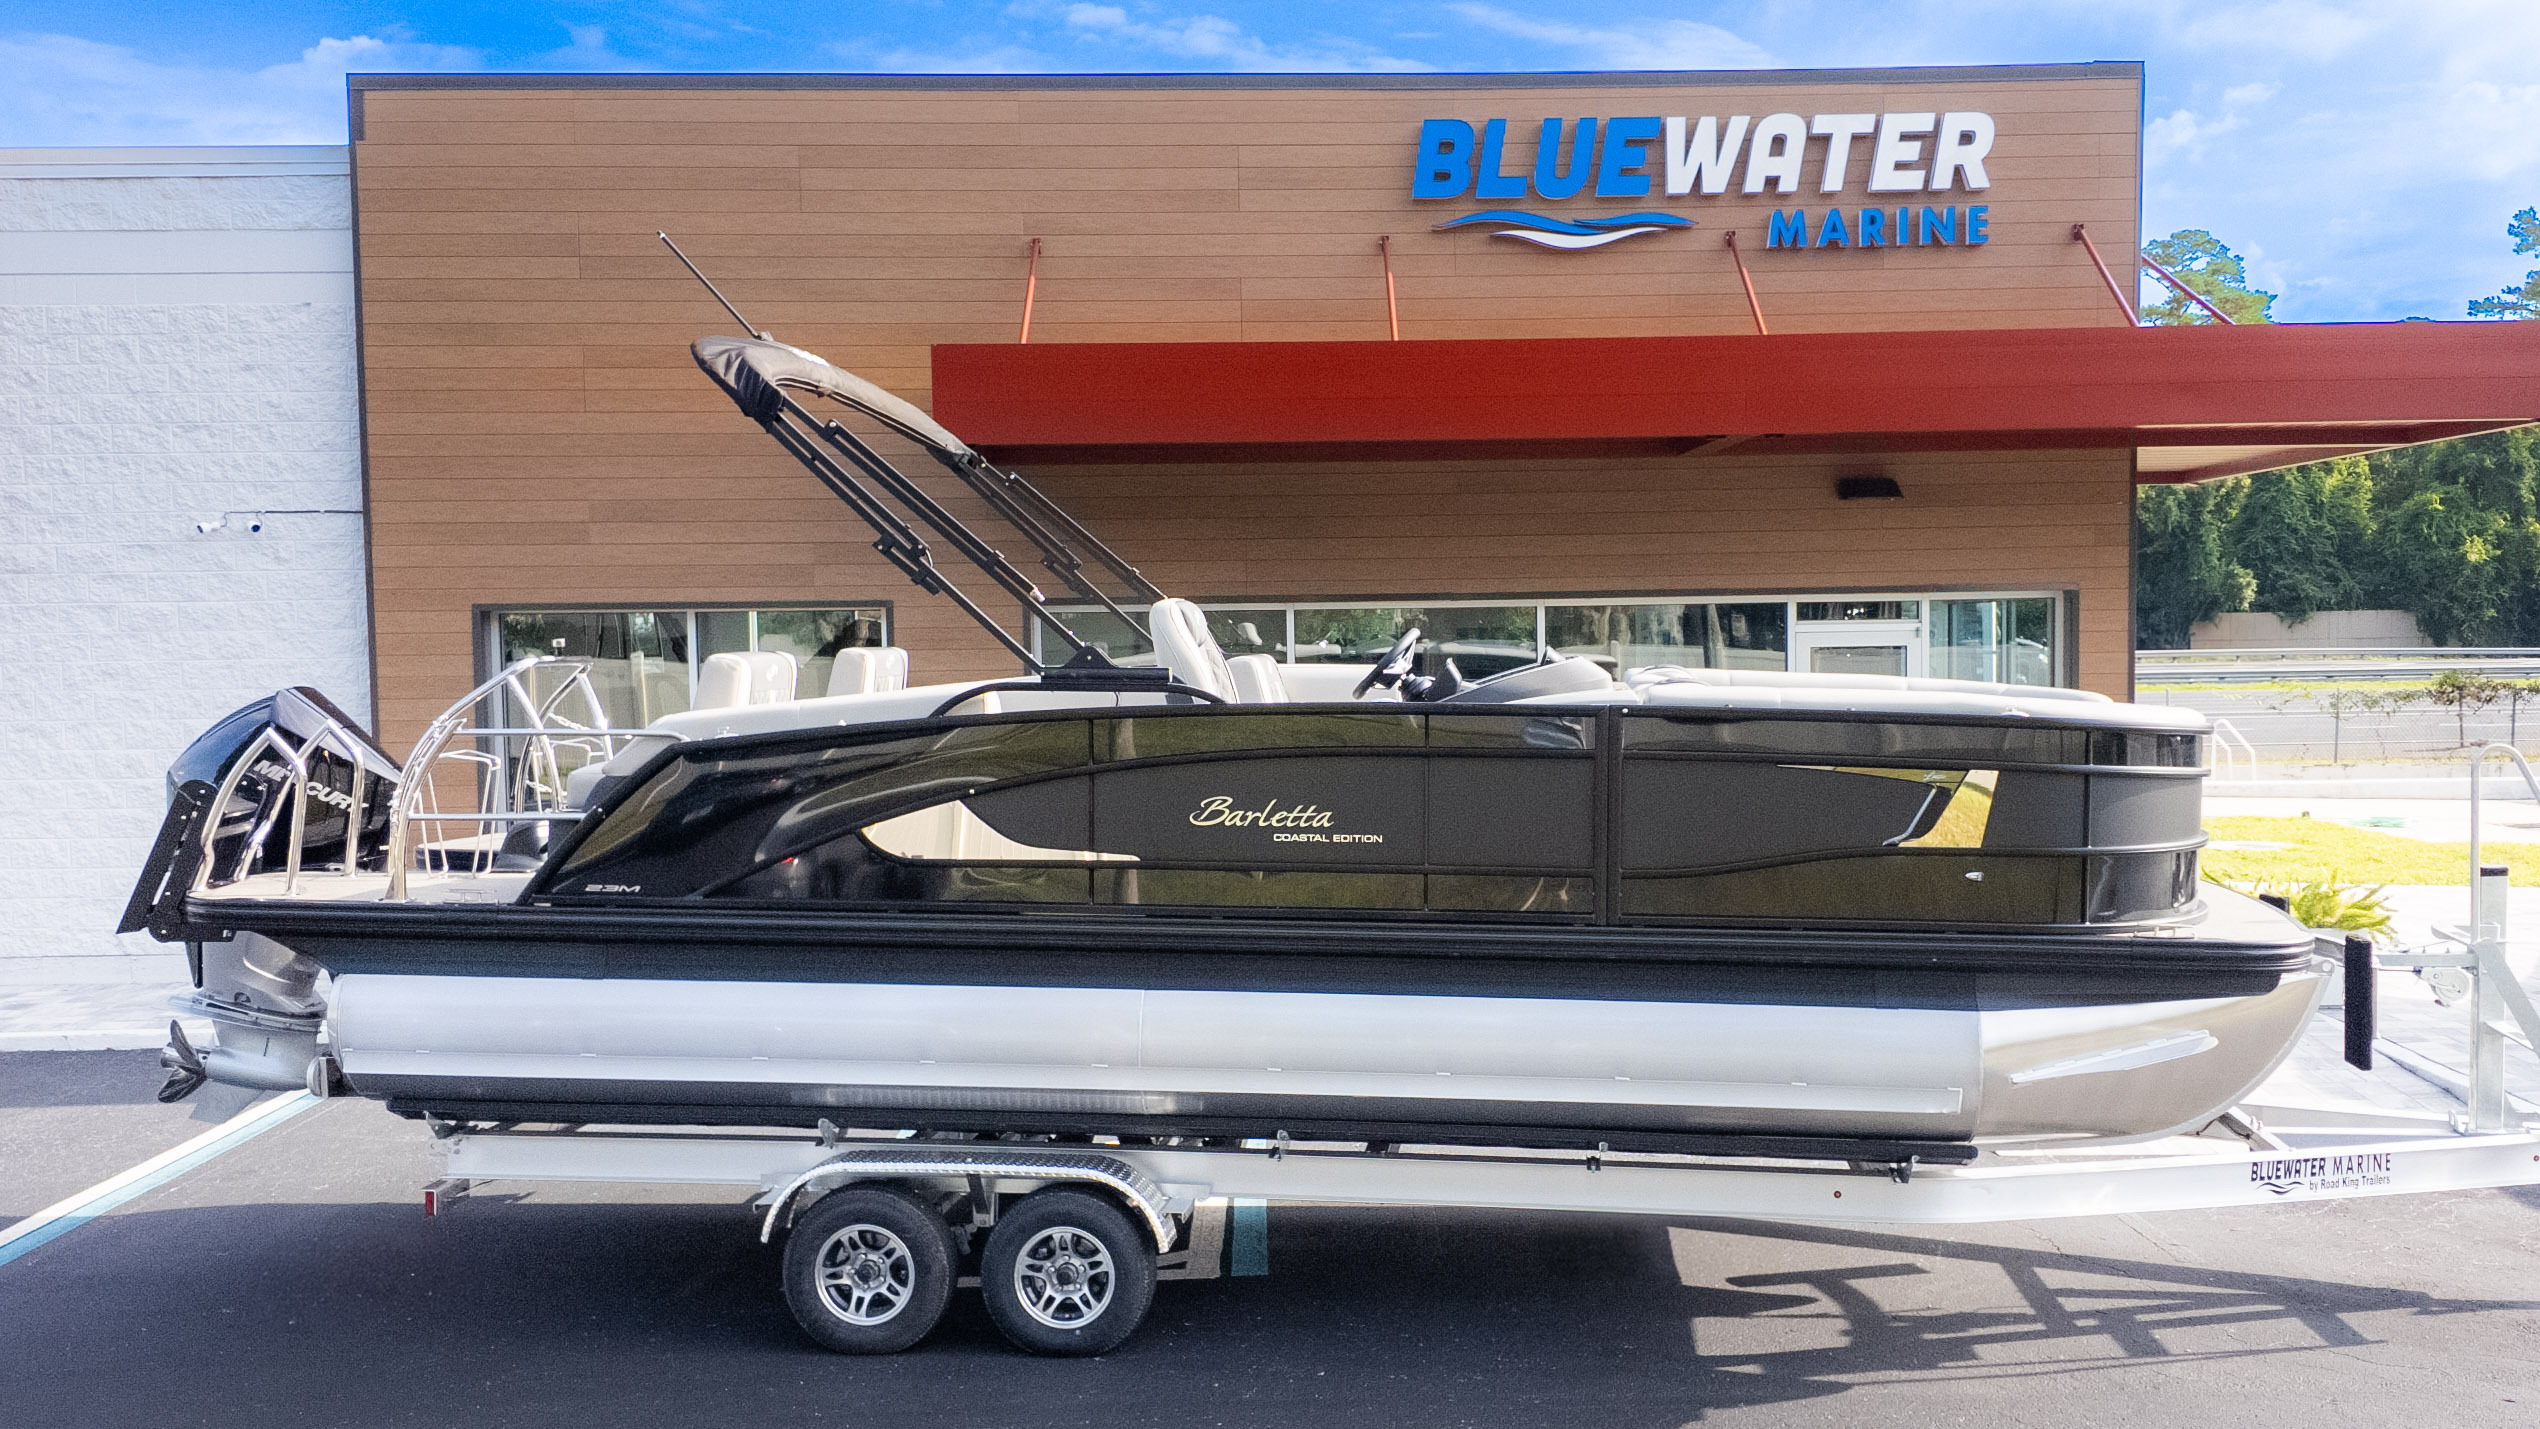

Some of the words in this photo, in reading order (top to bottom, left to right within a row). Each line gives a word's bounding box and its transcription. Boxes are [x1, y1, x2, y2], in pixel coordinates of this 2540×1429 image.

[1411, 111, 1996, 199] BLUEWATER
[1765, 205, 1990, 250] MARINE
[253, 759, 370, 812] MECUR
[1189, 795, 1335, 828] Barletta
[1273, 833, 1330, 843] COASTAL
[1332, 834, 1383, 844] EDITION
[585, 884, 641, 893] 23M
[2251, 1157, 2326, 1182] BLUEWATER
[2333, 1153, 2391, 1176] MARINE
[2309, 1180, 2319, 1192] by
[2321, 1177, 2340, 1190] Road
[2342, 1176, 2359, 1190] King
[2362, 1173, 2391, 1186] Trailers
